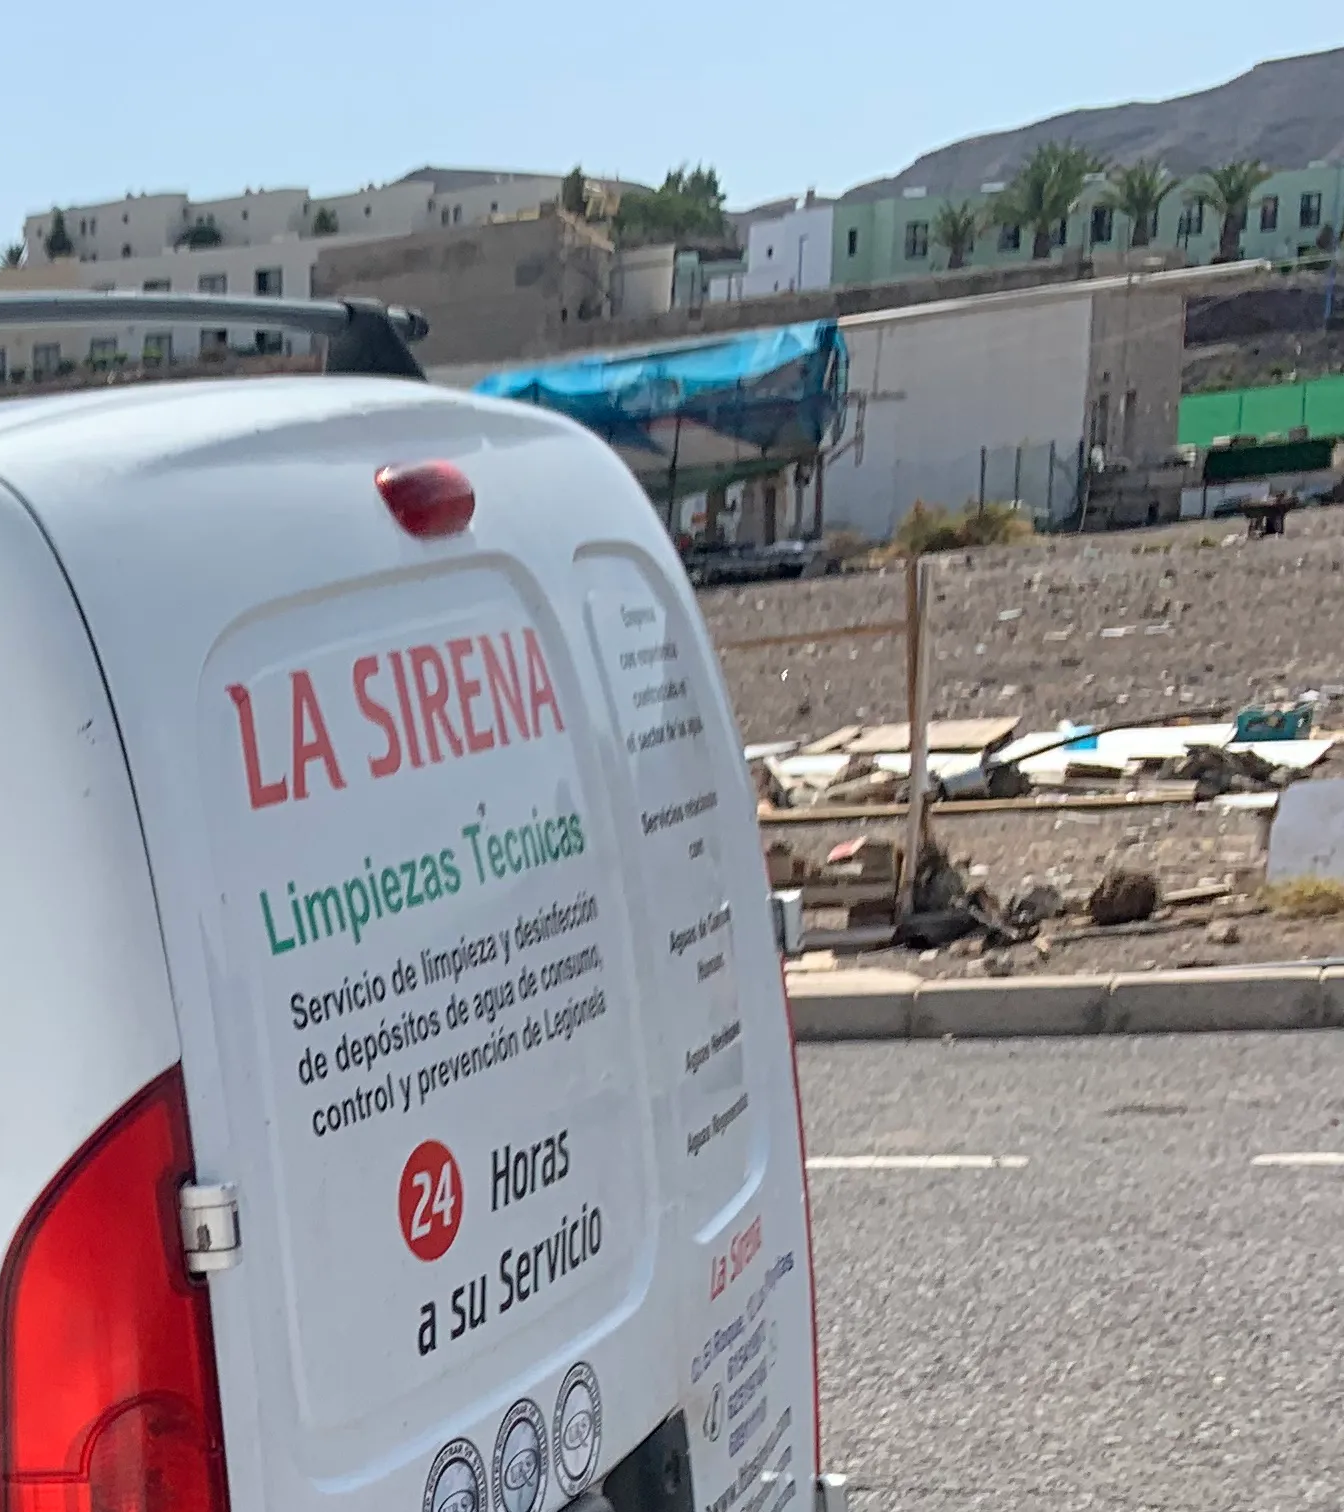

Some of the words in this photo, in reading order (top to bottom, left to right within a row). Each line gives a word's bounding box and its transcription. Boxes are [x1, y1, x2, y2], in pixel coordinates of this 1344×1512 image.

[226, 670, 347, 810] LA
[352, 627, 566, 779] SIRENA
[260, 848, 462, 956] Limpiezas
[290, 969, 387, 1031] Servicio
[392, 956, 418, 997] de
[421, 933, 498, 986] limpieza
[499, 928, 512, 965] y
[514, 890, 599, 952] desinfección
[298, 1046, 329, 1087] de
[335, 1009, 441, 1072] depósitos
[446, 991, 470, 1031] de
[473, 980, 515, 1025] agua
[518, 965, 538, 999] de
[540, 942, 604, 991] consumo,
[312, 1071, 395, 1137] control
[398, 1070, 414, 1113] y
[417, 1026, 520, 1106] prevención
[522, 1015, 543, 1052] de
[544, 984, 607, 1043] Legionela
[410, 1162, 456, 1241] 24
[490, 1128, 571, 1213] Horas
[417, 1305, 437, 1357] a
[450, 1275, 488, 1340] su
[498, 1205, 603, 1314] Servicio
